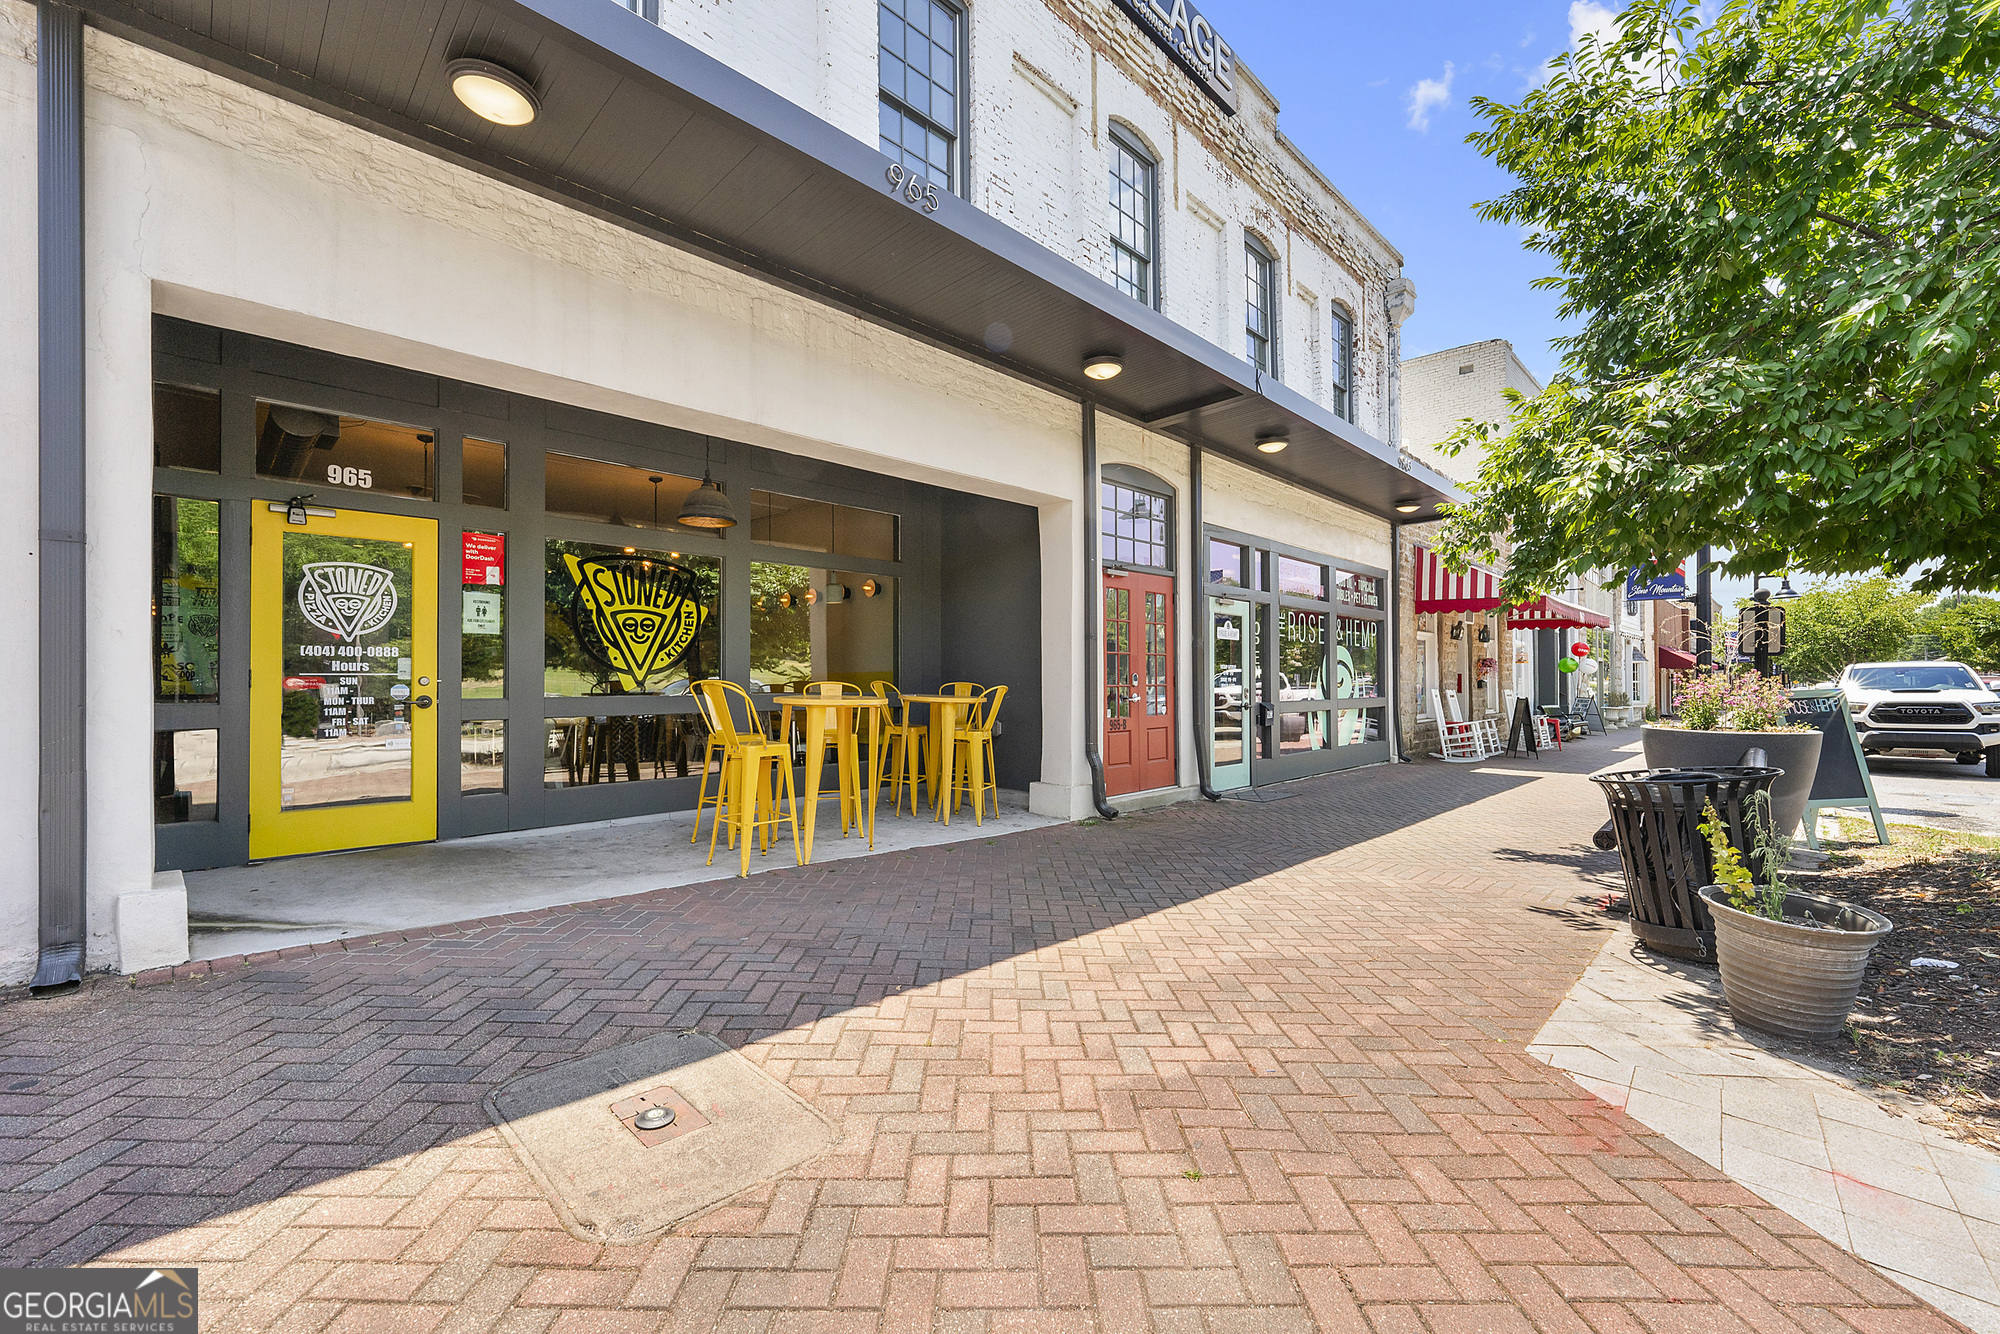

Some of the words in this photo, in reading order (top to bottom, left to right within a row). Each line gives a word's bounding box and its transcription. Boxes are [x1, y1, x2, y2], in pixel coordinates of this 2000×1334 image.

[889, 164, 939, 211] 965
[327, 464, 373, 488] 965
[314, 567, 383, 595] STONED
[593, 565, 683, 609] STONED
[1649, 584, 1685, 596] Mountain
[305, 592, 327, 624] PIZZA
[367, 595, 392, 626] KITCHEN
[664, 610, 694, 660] KITCHEN
[1288, 611, 1325, 644] ROSE
[1336, 619, 1343, 641] &
[1346, 619, 1377, 648] HEMP
[300, 645, 335, 657] (404)
[337, 646, 399, 657] 400-0888
[331, 660, 370, 671] Hours
[340, 677, 358, 685] SUN
[326, 686, 348, 695] 11AM
[323, 697, 345, 705] MON
[351, 696, 374, 705] THUR
[1815, 698, 1839, 713] HEMP
[324, 707, 346, 716] 11AM
[332, 718, 346, 726] FRI
[353, 717, 369, 726] SAT
[324, 729, 347, 737] 11AM
